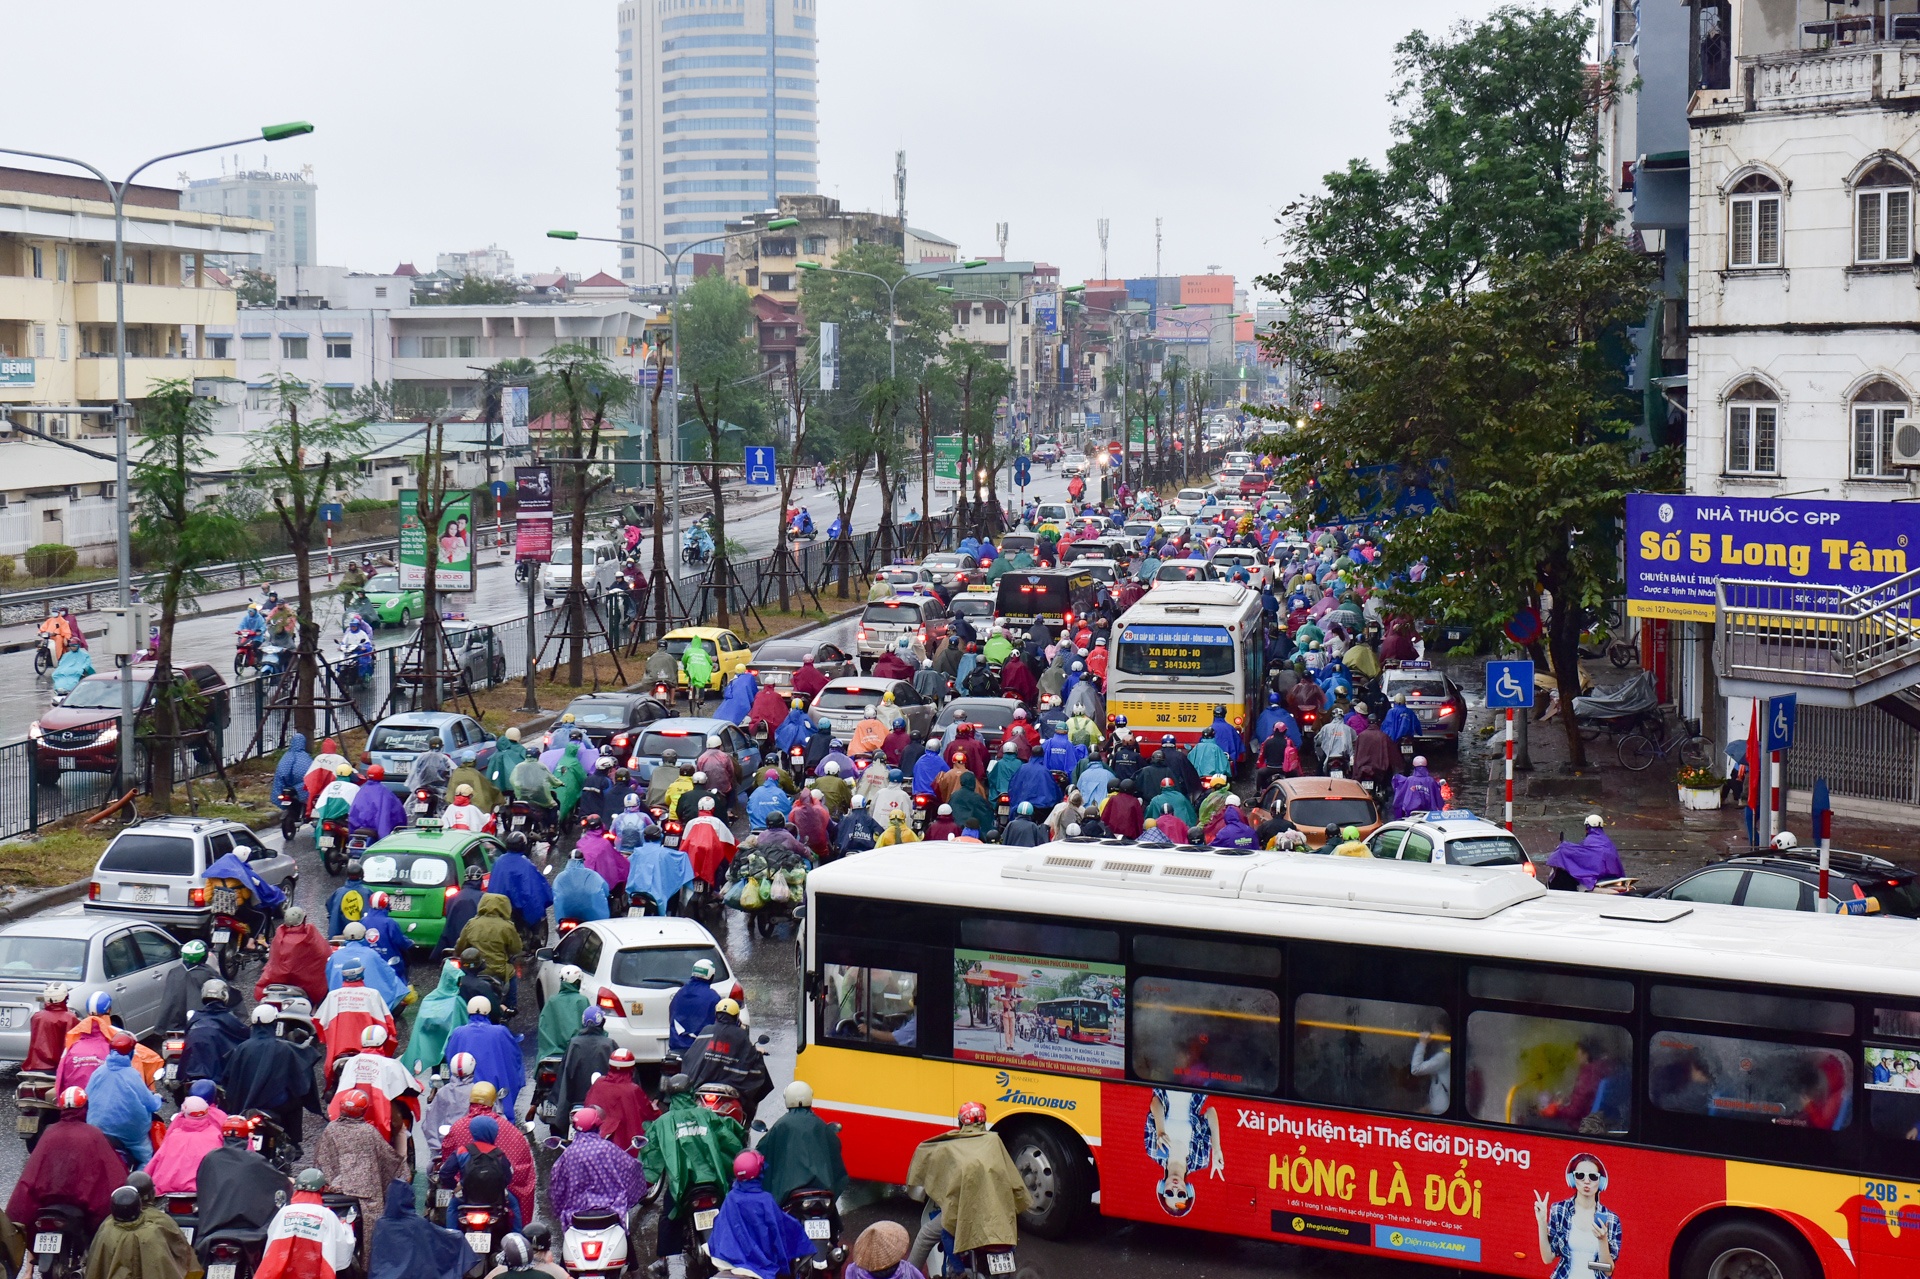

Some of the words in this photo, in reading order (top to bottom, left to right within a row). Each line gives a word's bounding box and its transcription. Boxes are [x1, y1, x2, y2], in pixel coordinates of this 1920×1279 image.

[274, 172, 304, 181] BANK
[1697, 506, 1734, 521] NHÀ
[1739, 506, 1799, 524] THUỐC
[1804, 511, 1841, 525] GPP
[1640, 530, 1682, 561] Số
[1690, 533, 1710, 563] 5
[1721, 534, 1810, 576] Long
[1822, 538, 1907, 573] Tâm
[1640, 572, 1668, 582] CHUYÊN
[1671, 572, 1687, 583] BÁN
[1688, 572, 1696, 584] LẺ
[1655, 605, 1665, 613] 127
[1162, 648, 1177, 656] BUS
[1193, 649, 1200, 657] 10
[1165, 661, 1200, 669] 38436393
[1156, 714, 1170, 722] 30Z
[706, 1040, 731, 1055] ABB
[996, 1088, 1077, 1110] HANOIBUS
[1237, 1109, 1264, 1130] Xài
[1268, 1115, 1303, 1139] phụ
[1307, 1118, 1345, 1143] kiện
[1349, 1125, 1372, 1148] tại
[1374, 1127, 1411, 1149] Thế
[1414, 1133, 1450, 1155] Giới
[1454, 1137, 1473, 1157] Di
[1477, 1142, 1530, 1169] Động
[1269, 1145, 1356, 1200] HỎNG
[1369, 1161, 1412, 1206] LÀ
[1424, 1159, 1482, 1218] ĐỔI
[1865, 1182, 1897, 1202] 29B
[1366, 1211, 1384, 1220] phòng
[1387, 1213, 1398, 1222] Thẻ
[1423, 1219, 1437, 1227] nghe
[1441, 1221, 1452, 1229] Cáp
[1306, 1222, 1349, 1236] thegioididong
[1404, 1237, 1422, 1247] Điện
